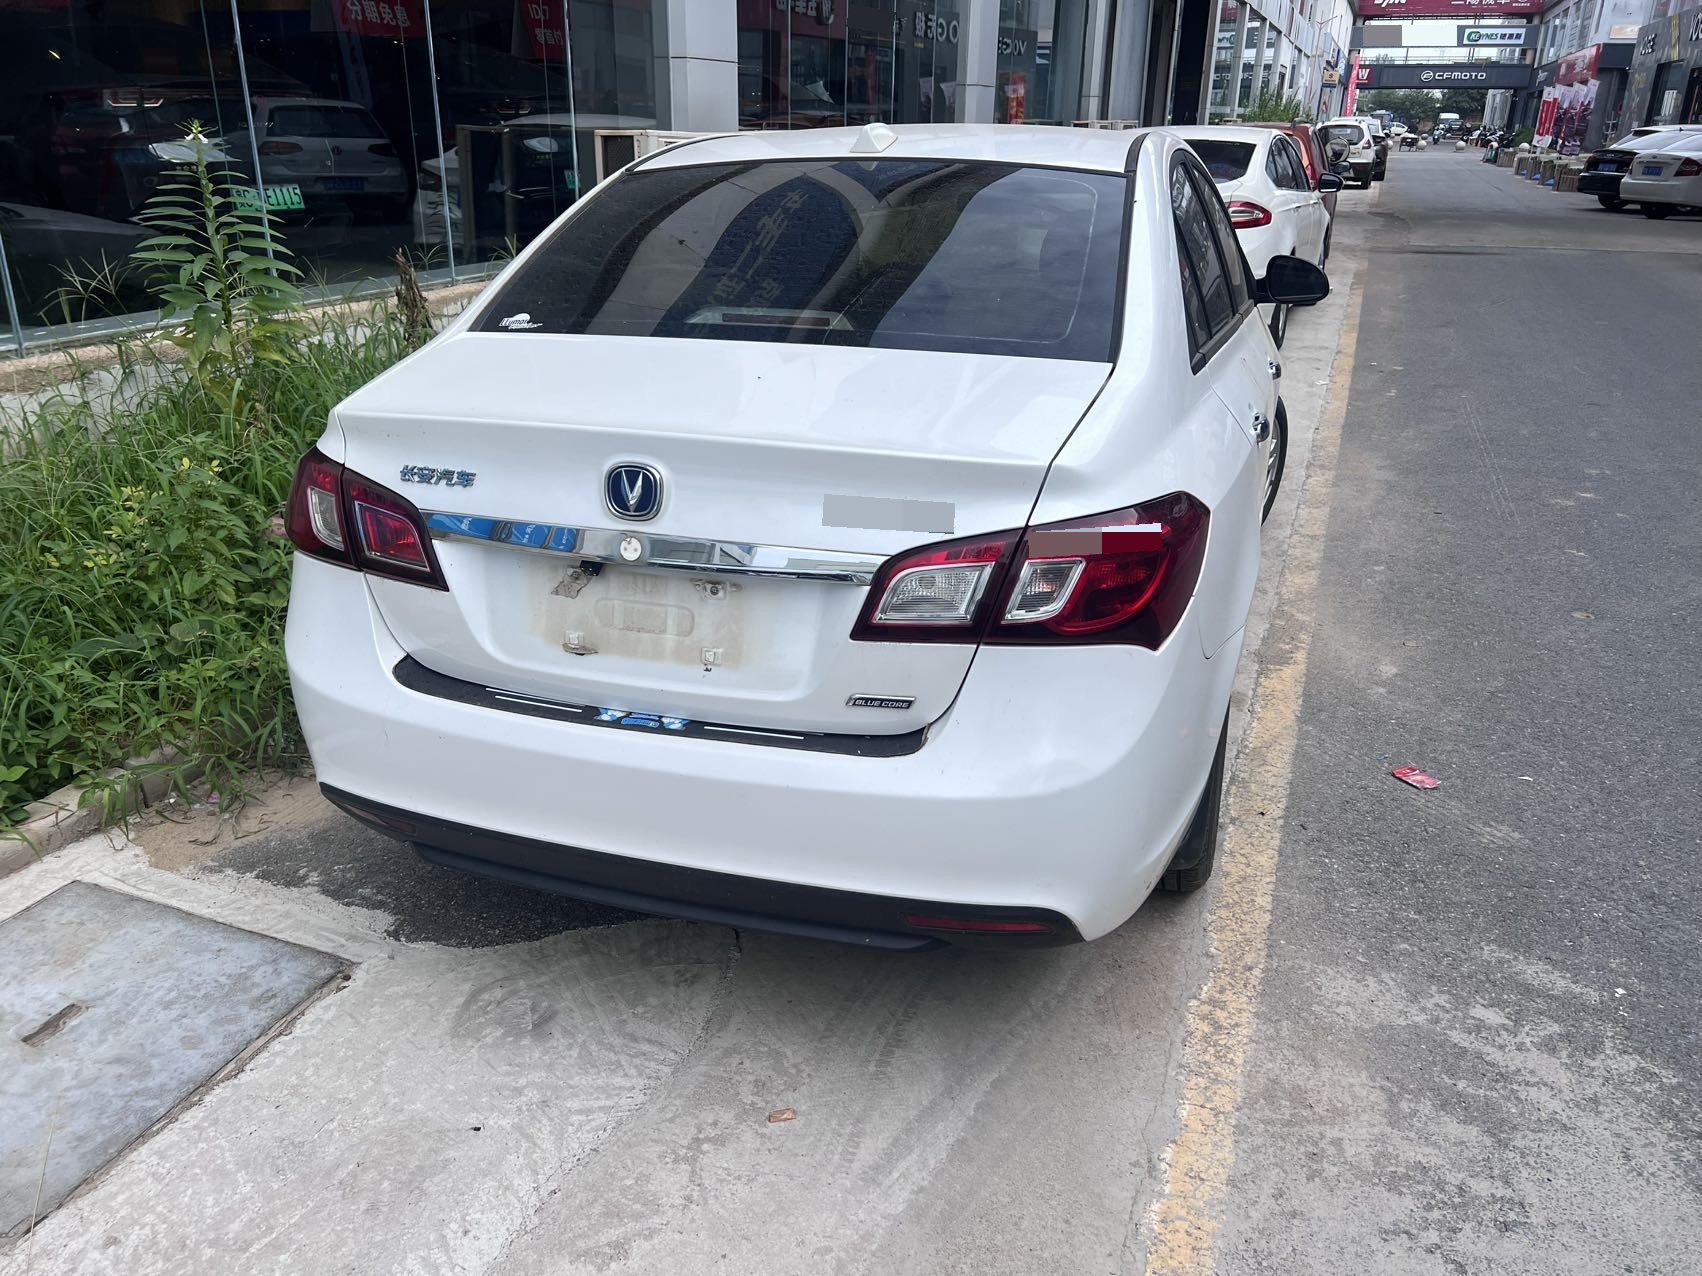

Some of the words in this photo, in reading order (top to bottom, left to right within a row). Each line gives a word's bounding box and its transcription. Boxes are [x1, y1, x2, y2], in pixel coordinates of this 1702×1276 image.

[1435, 71, 1486, 80] CFMOTO
[399, 465, 477, 488] 长安汽车
[854, 699, 881, 707] BLUE
